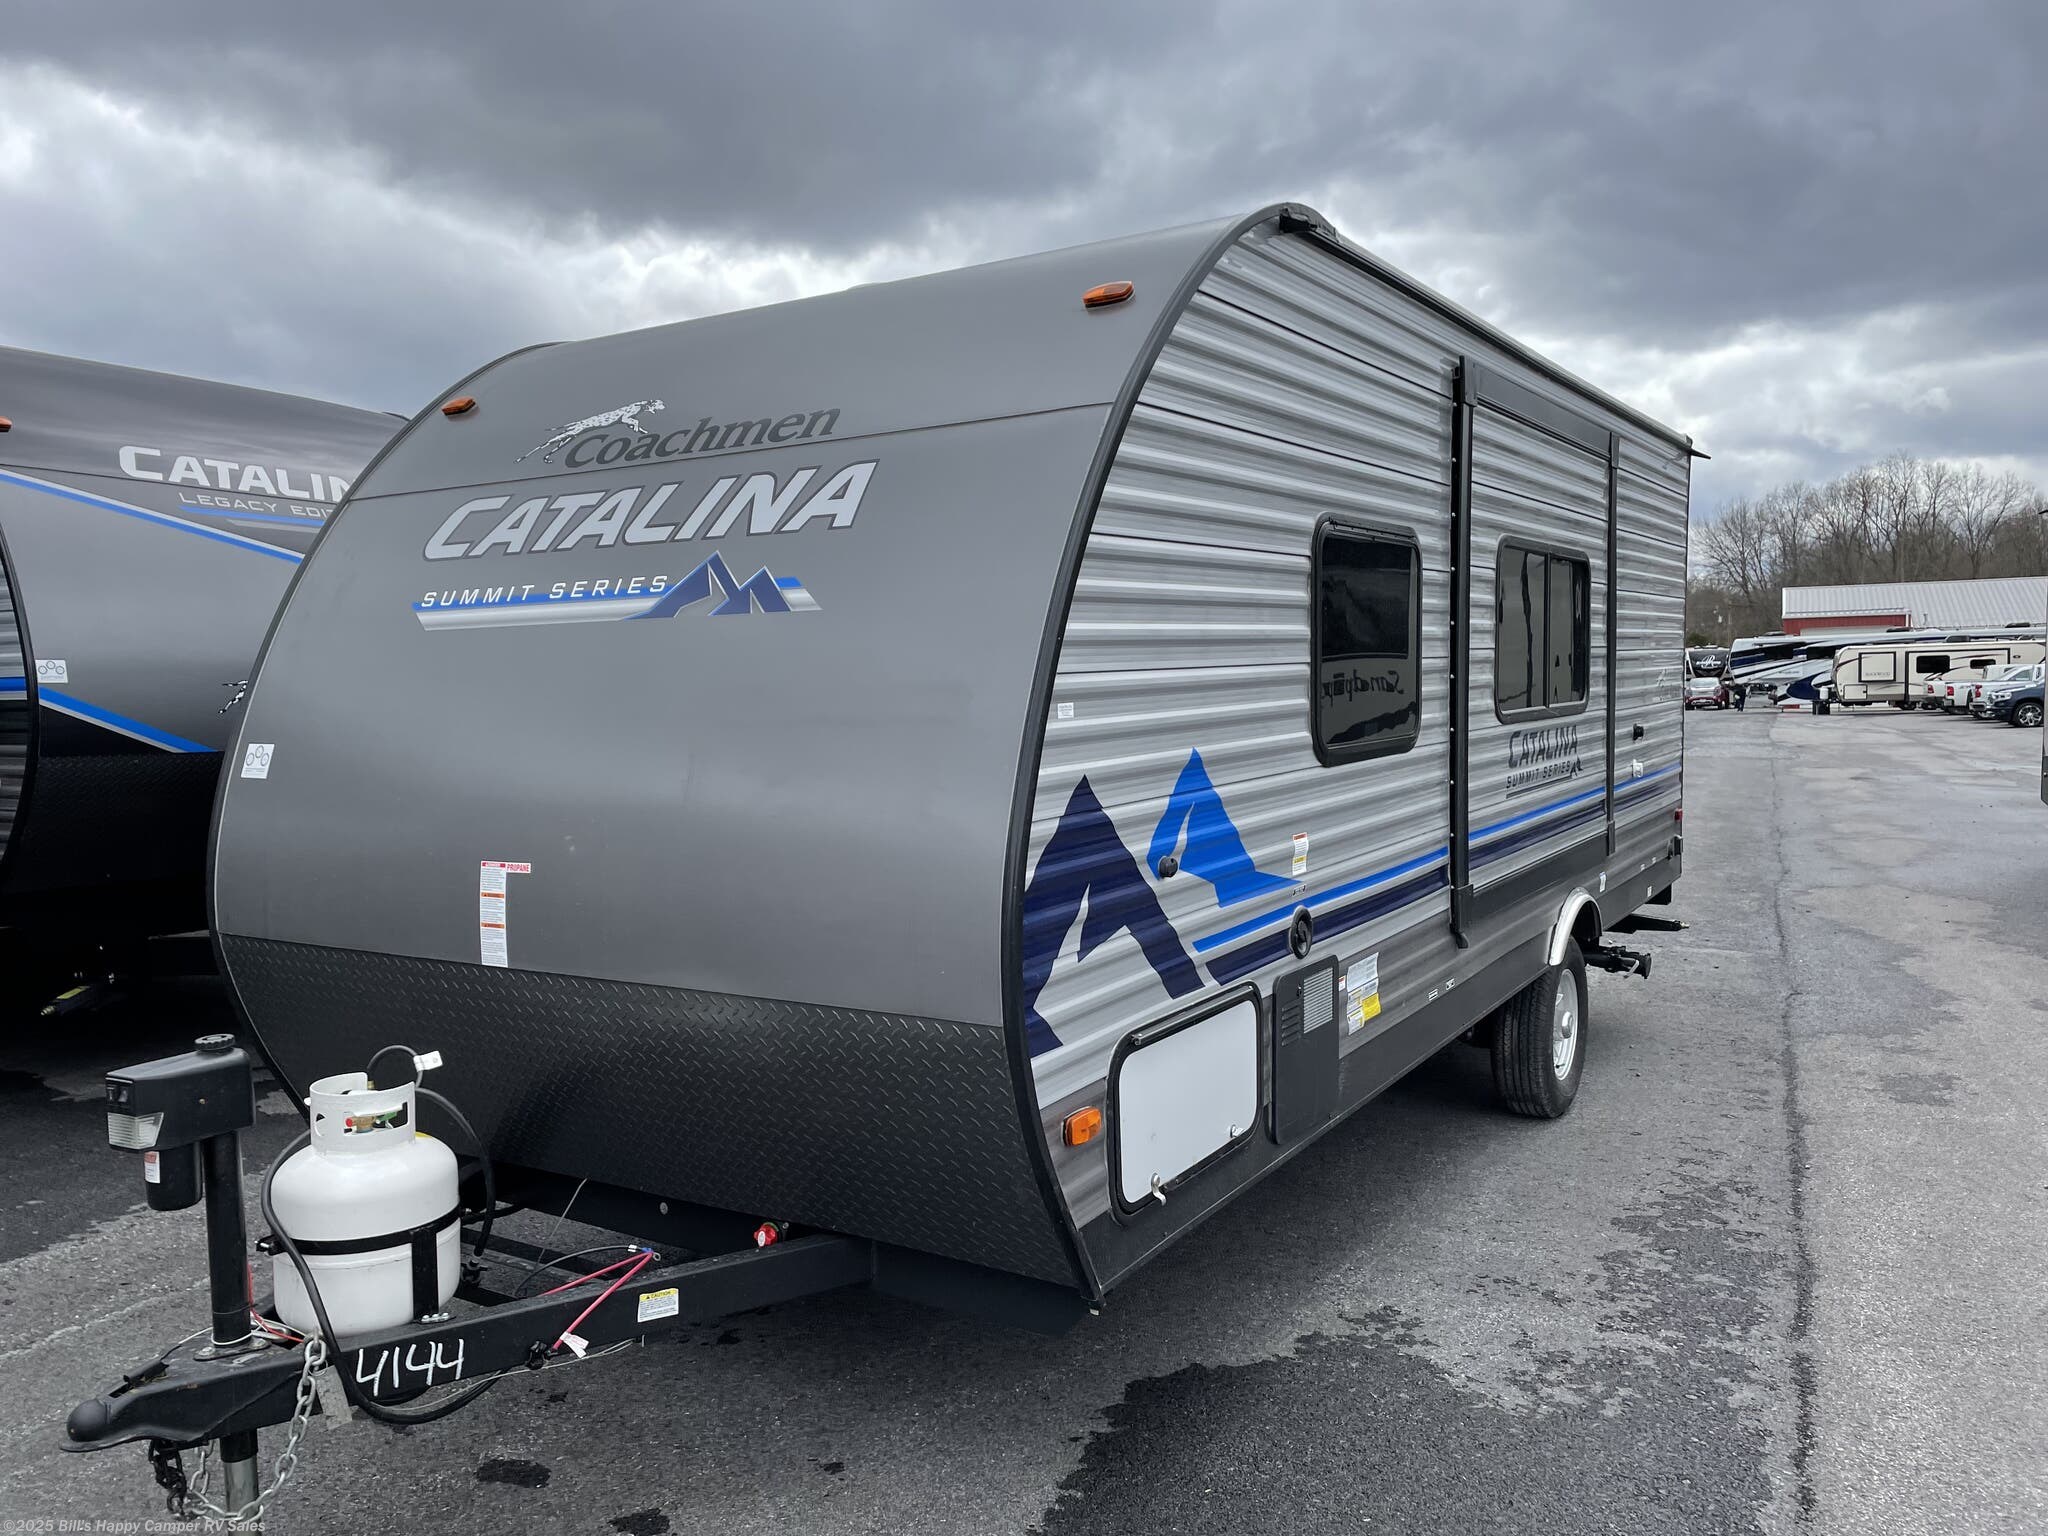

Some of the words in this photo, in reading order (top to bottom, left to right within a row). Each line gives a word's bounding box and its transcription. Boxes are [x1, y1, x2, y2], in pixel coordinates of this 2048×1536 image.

[564, 408, 841, 468] Coachmen
[178, 492, 277, 513] LEGACY
[422, 458, 880, 562] CATALINA
[421, 584, 535, 608] SUMMIT
[549, 575, 668, 599] SERIES
[1508, 725, 1578, 768] CATALINA
[1506, 768, 1540, 789] SUMMIT
[1543, 760, 1571, 778] SERIES
[506, 863, 530, 873] PROPANE
[356, 1339, 464, 1397] 4144
